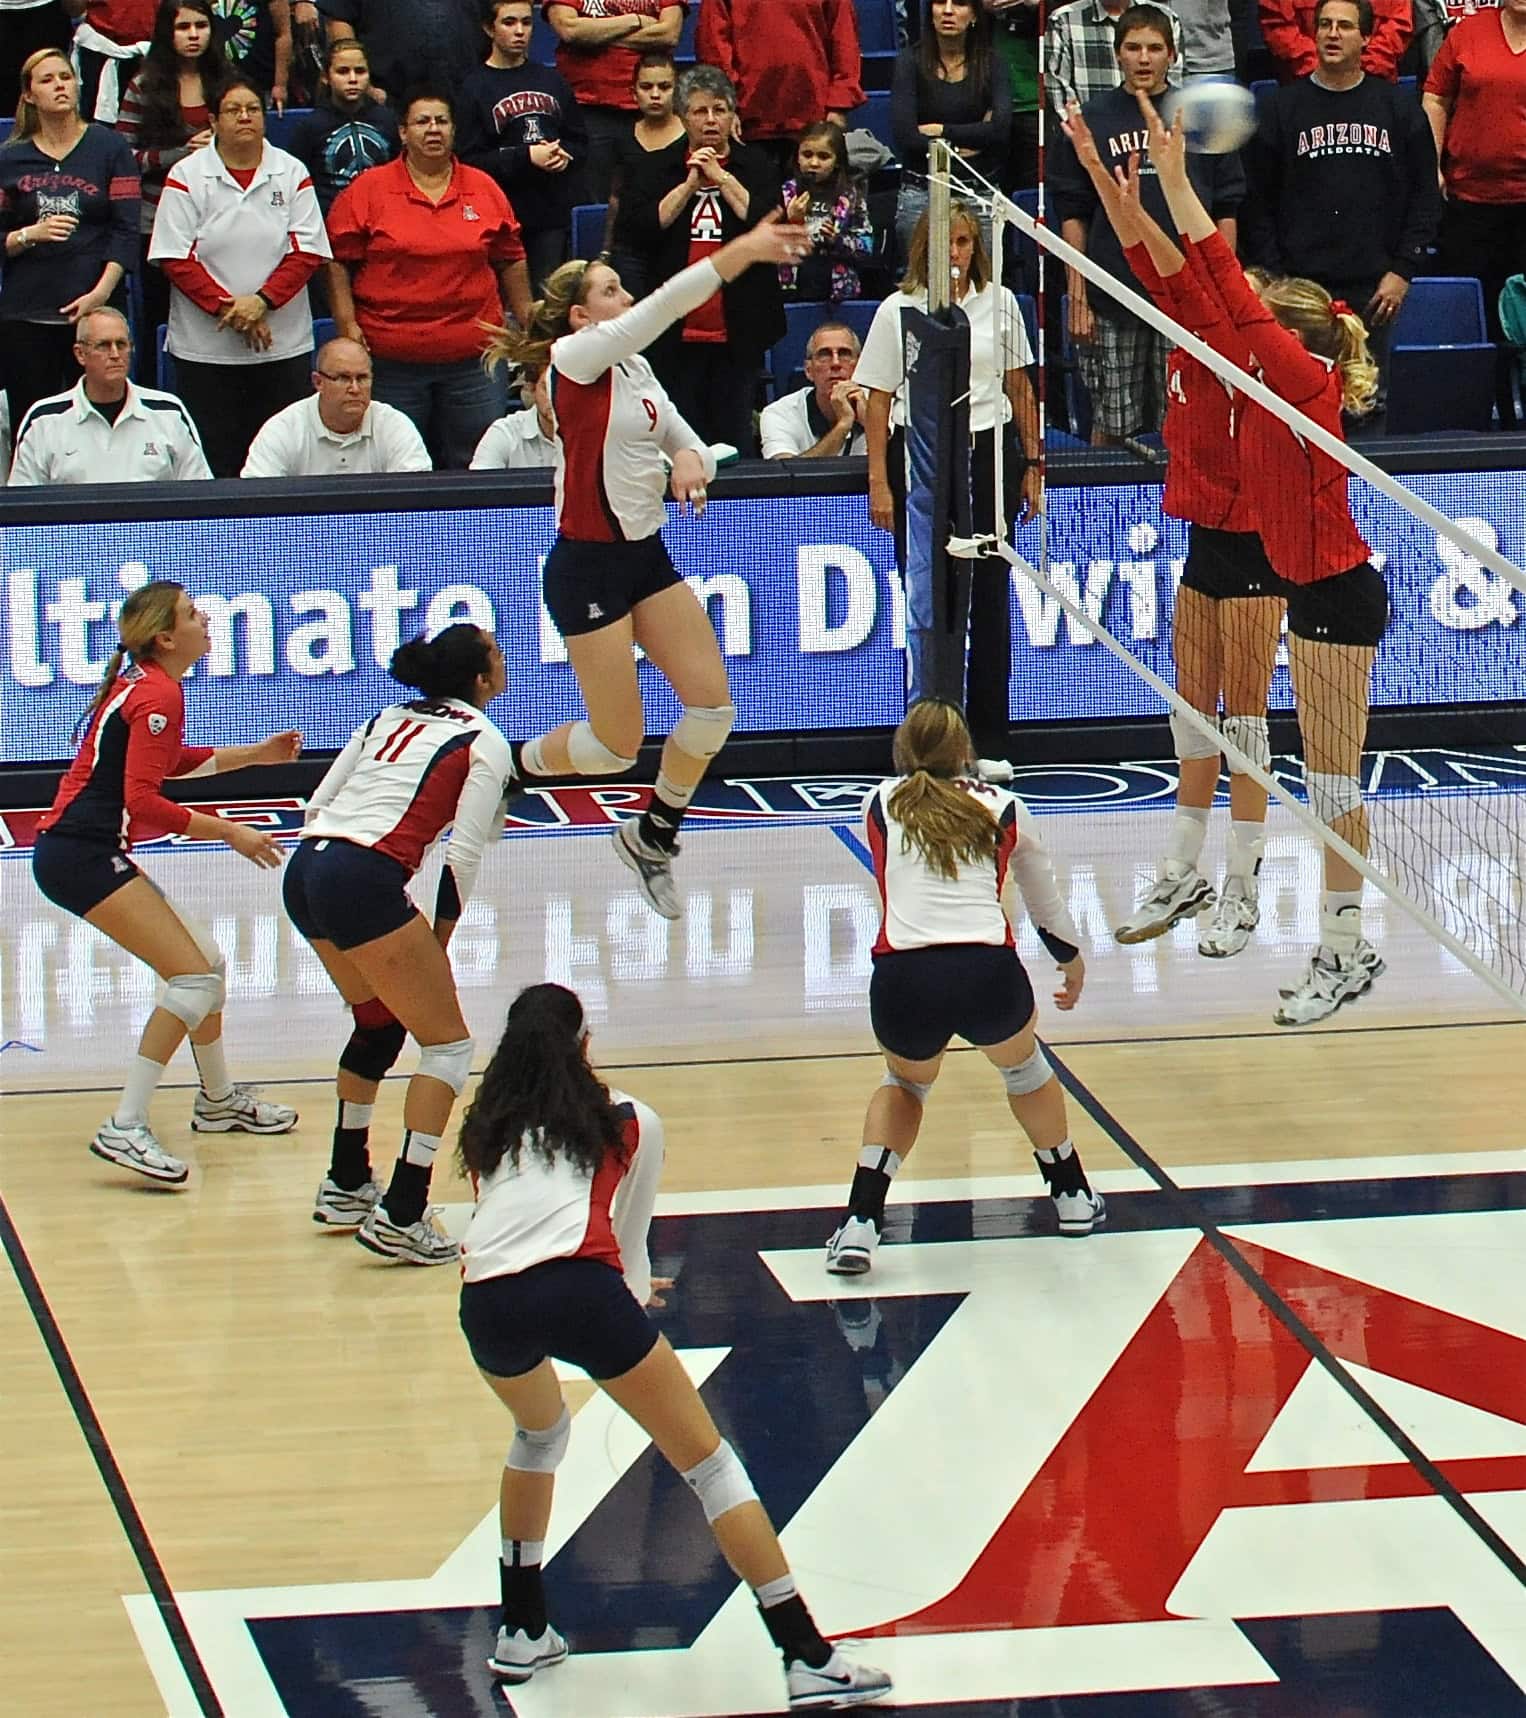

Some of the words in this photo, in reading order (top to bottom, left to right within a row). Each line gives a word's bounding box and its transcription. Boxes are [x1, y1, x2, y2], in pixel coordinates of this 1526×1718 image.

[1108, 129, 1150, 157] ARIZ
[1297, 123, 1391, 156] ARIZONA
[1309, 146, 1380, 159] WILDCATS
[641, 398, 658, 433] 9
[374, 718, 428, 762] 11
